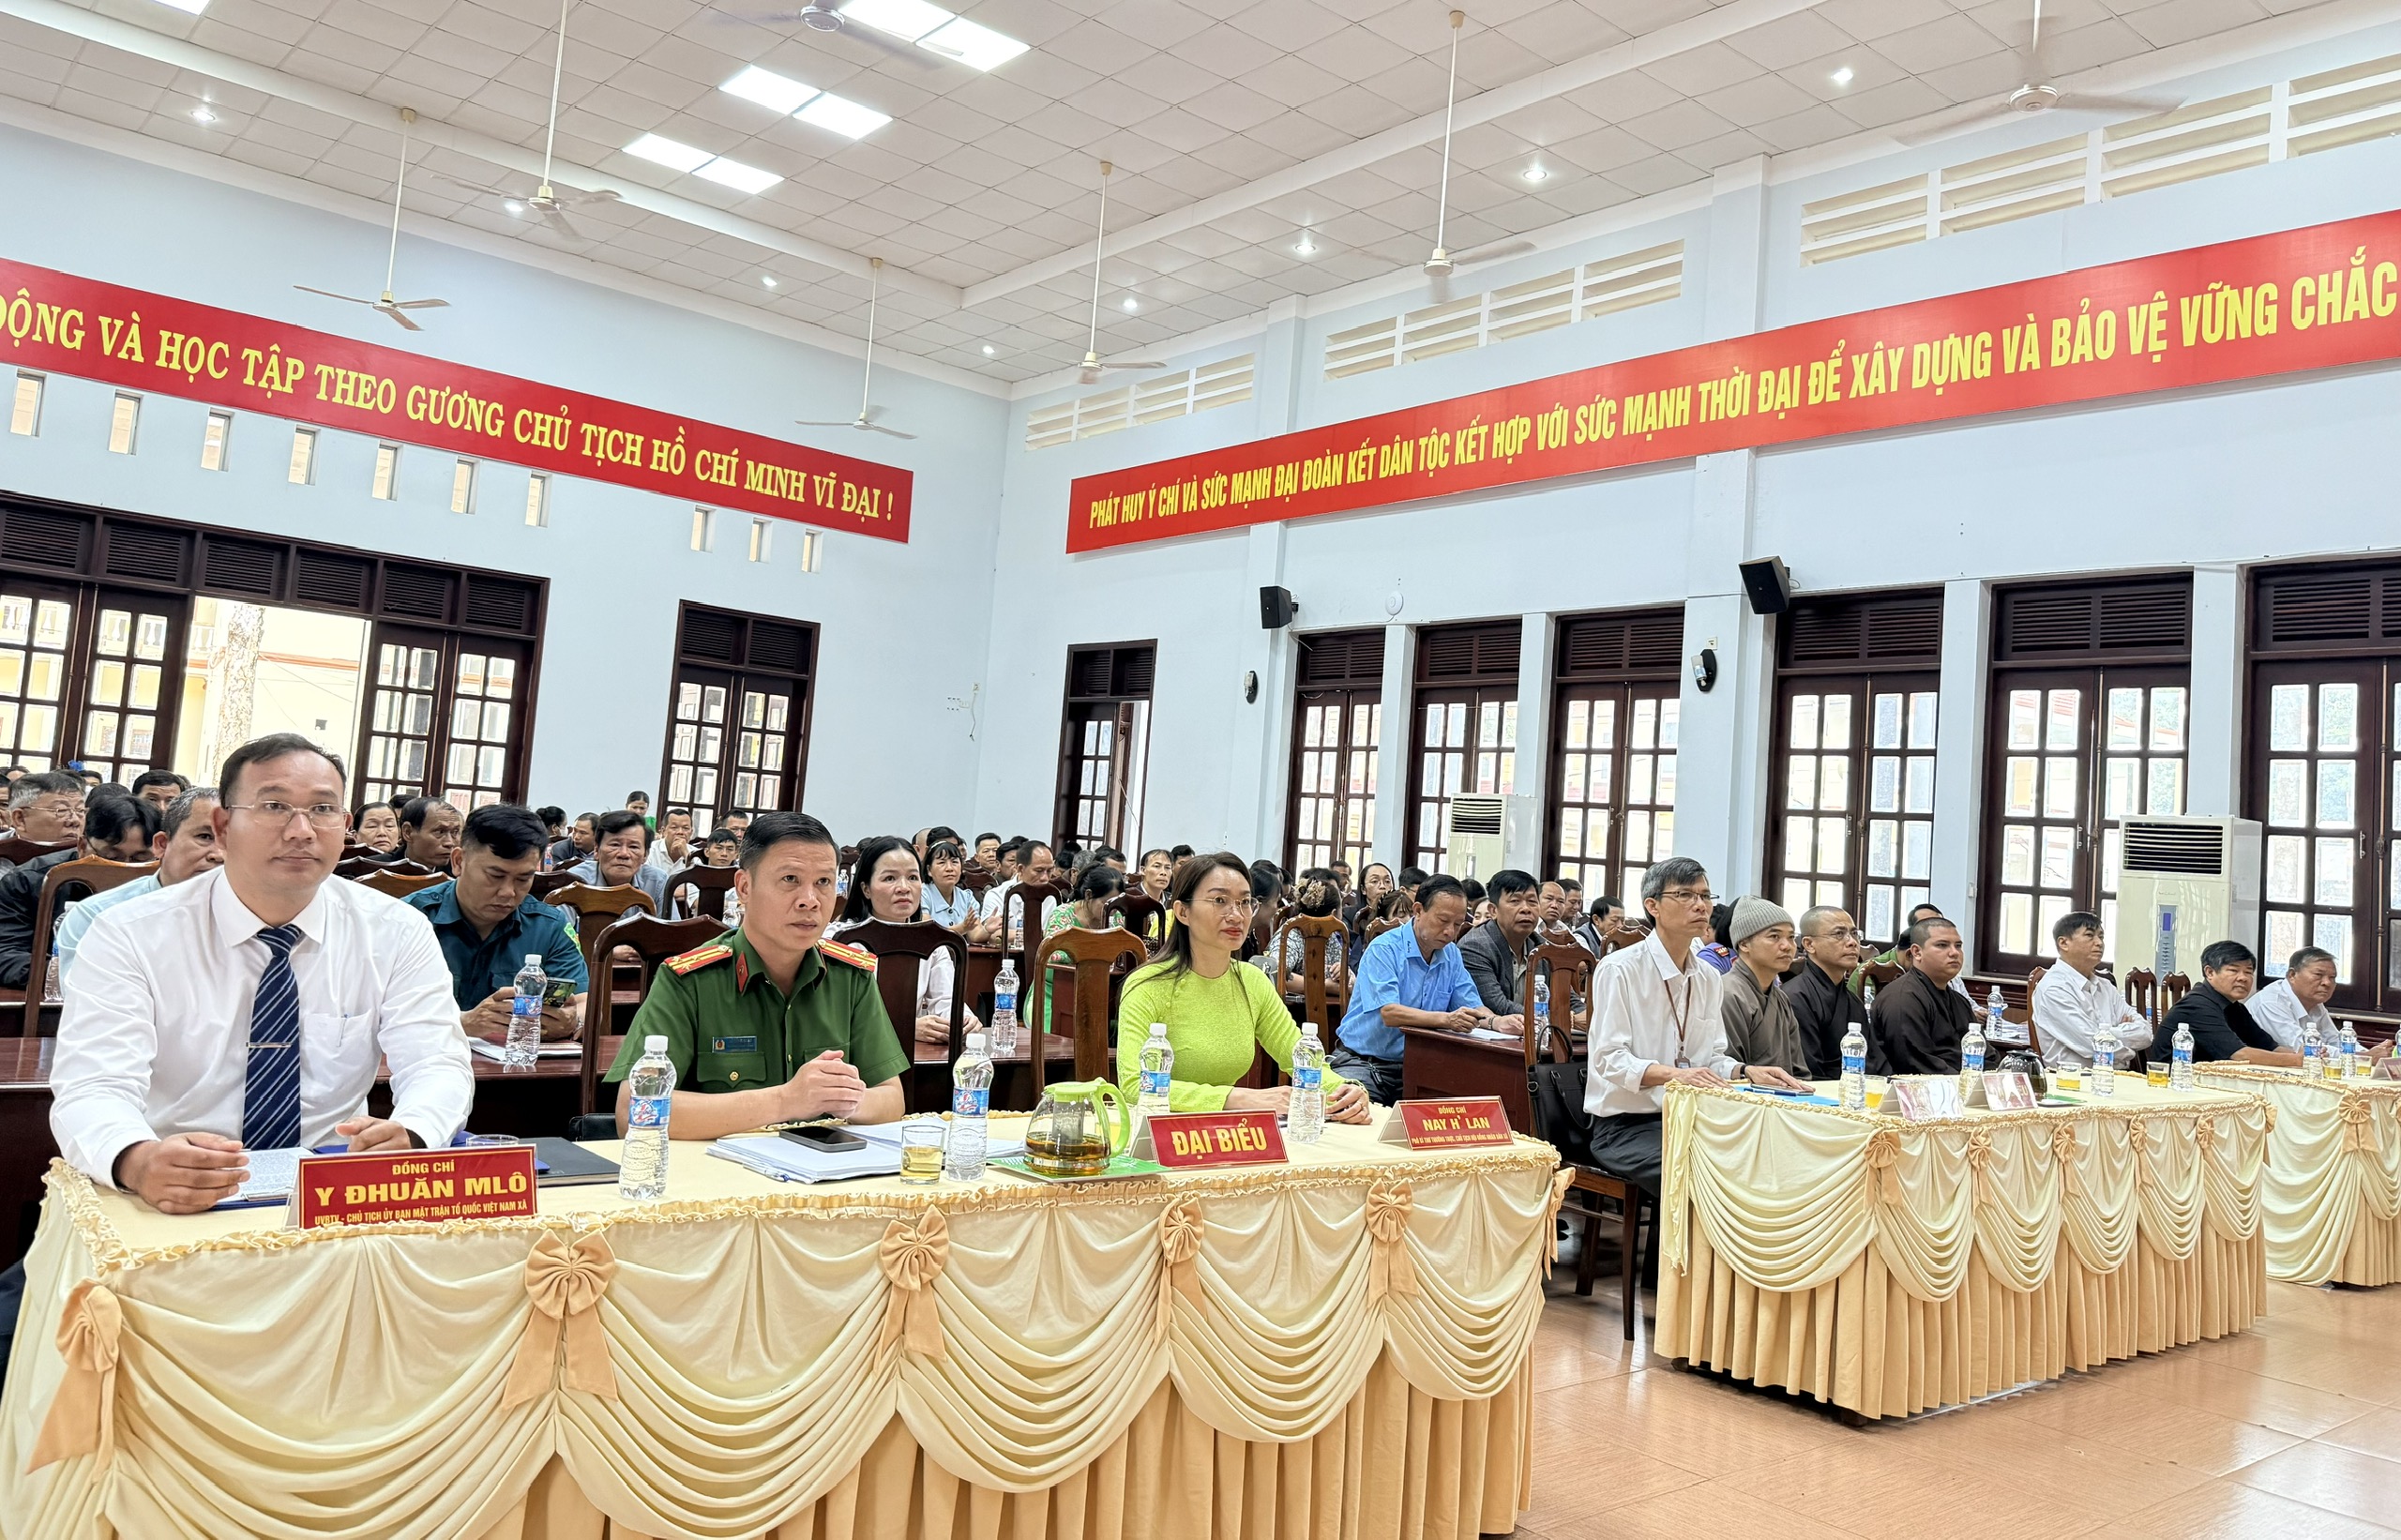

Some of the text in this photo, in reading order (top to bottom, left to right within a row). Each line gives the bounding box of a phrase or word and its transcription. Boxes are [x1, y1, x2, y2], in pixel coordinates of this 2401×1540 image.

[1089, 245, 2399, 529] PHÁT HUY Ý CHÍ VÀ SỨC MẠNH ĐẠI ĐOÀN KẾT DÂN TỘC KẾT HỢP VỚI SỨC MẠNH THỜI ĐẠI ĐỂ XÂY DỰNG VÀ BẢO VỆ VỮNG CHẮC
[98, 311, 144, 363] VÀ
[155, 330, 230, 384] HỌC
[241, 343, 306, 400] TẬP
[314, 364, 397, 415] THEO
[406, 385, 506, 438] GƯƠNG
[513, 404, 572, 451] CHỦ
[581, 422, 644, 467] TỊCH
[649, 425, 687, 476] HỒ
[694, 448, 739, 488] CHÍ
[744, 460, 808, 503] MINH
[812, 471, 838, 509] VĨ
[840, 481, 882, 523] ĐẠI
[886, 491, 894, 521] !
[1170, 1117, 1267, 1159] ĐẠI BIỂU
[1422, 1118, 1447, 1131] NAY
[1465, 1117, 1490, 1129] LAN
[433, 1159, 455, 1173] CHÍ
[314, 1171, 527, 1207] Y ĐHUĂN MLÔ
[347, 1210, 363, 1223] CHỦ
[364, 1211, 382, 1224] TỊCH
[395, 1209, 411, 1219] BAN
[431, 1204, 449, 1218] TRẬN
[462, 1201, 481, 1215] QUỐC
[483, 1201, 498, 1215] VIỆT
[499, 1200, 516, 1212] NAM
